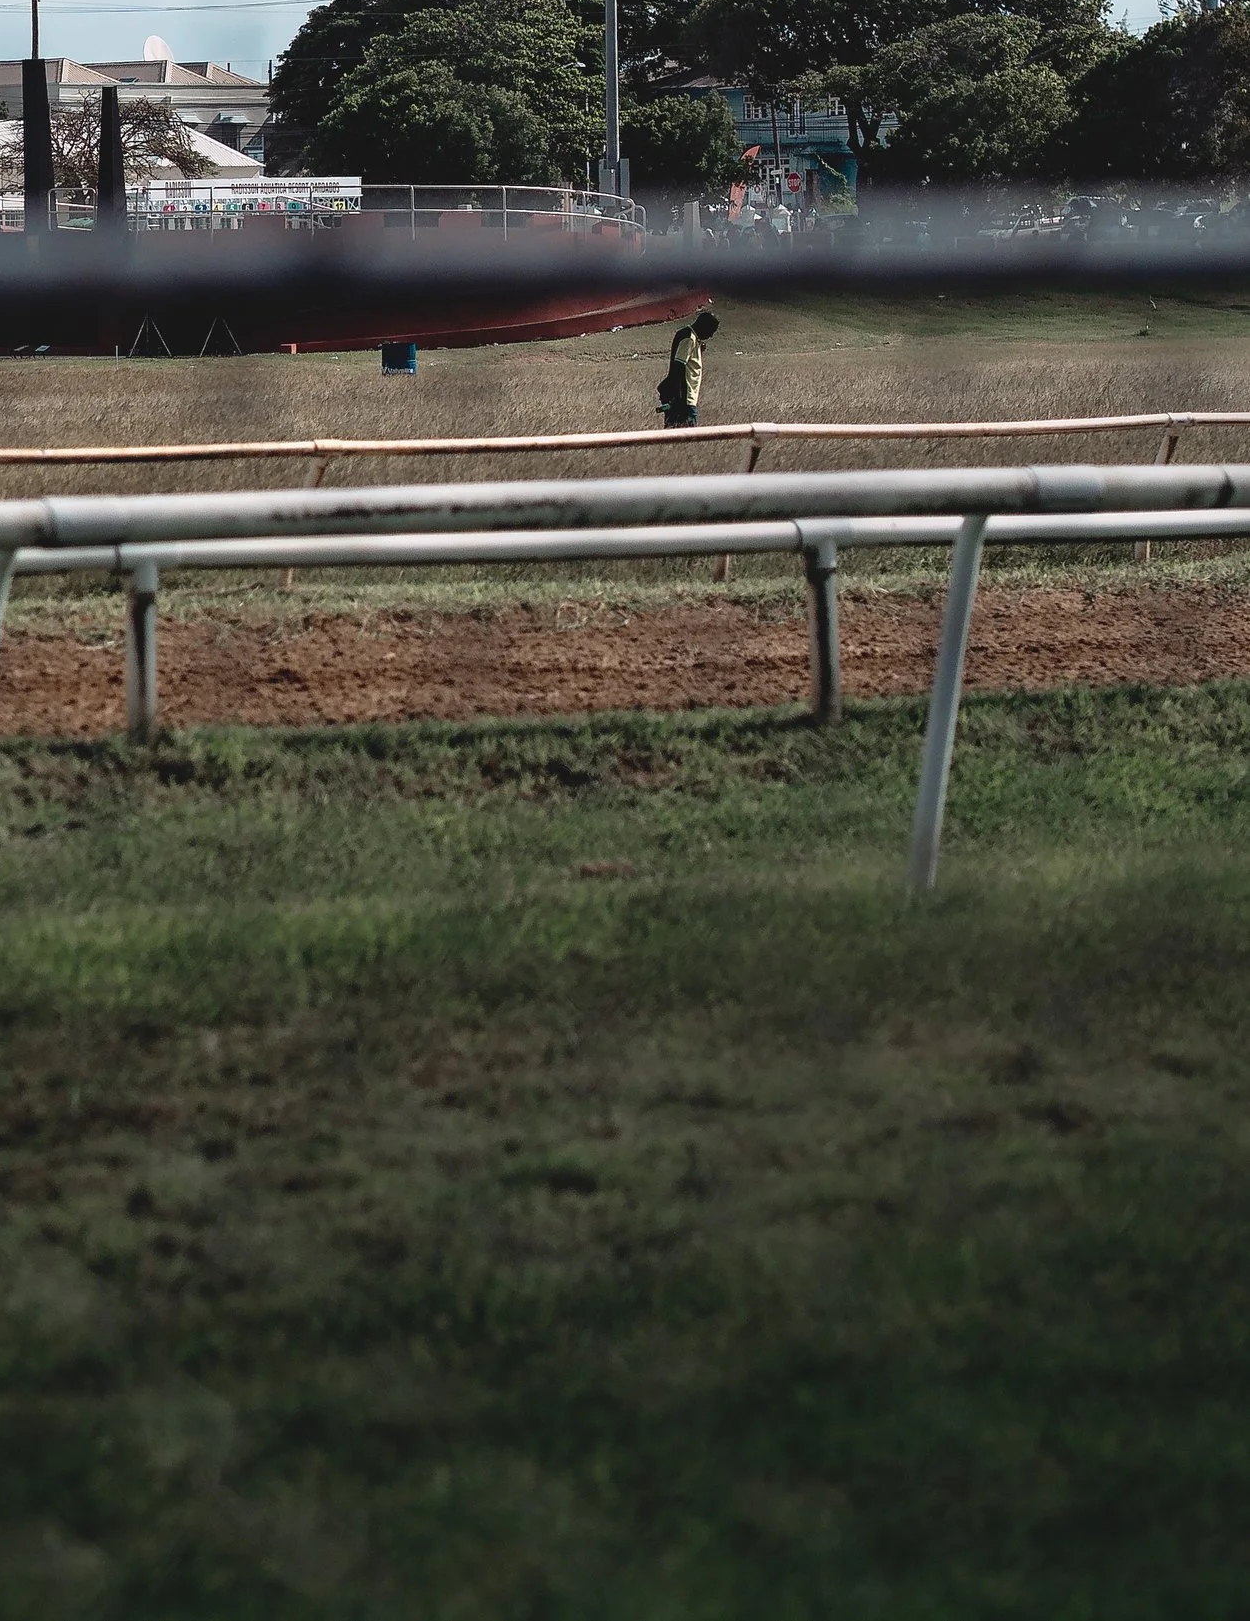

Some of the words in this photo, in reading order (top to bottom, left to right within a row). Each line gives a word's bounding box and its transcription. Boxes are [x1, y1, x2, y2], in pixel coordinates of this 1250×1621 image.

[789, 178, 800, 187] STOP
[231, 183, 259, 195] RADISSON
[260, 182, 287, 194] AQUATICA
[288, 182, 309, 193] RESORT
[311, 182, 340, 193] BARBADOS
[335, 202, 344, 210] 12
